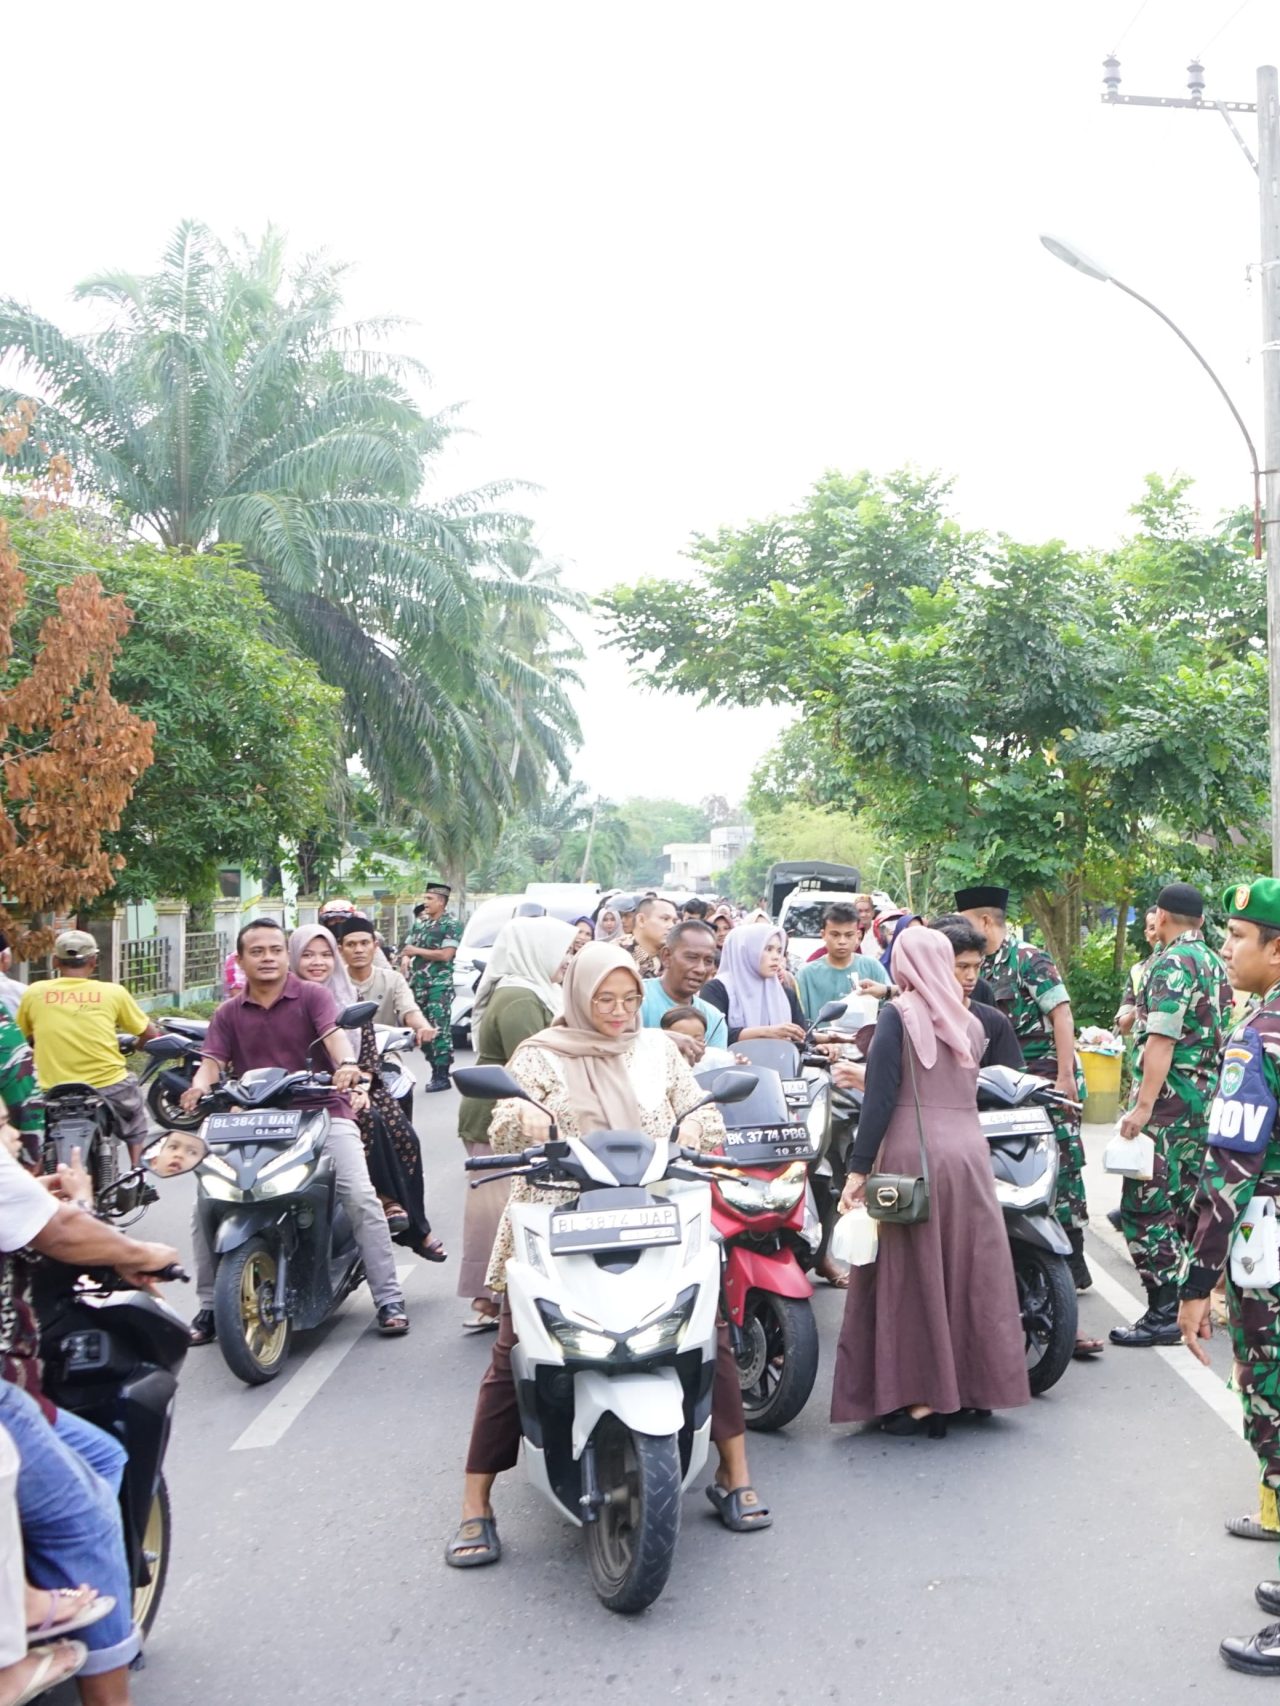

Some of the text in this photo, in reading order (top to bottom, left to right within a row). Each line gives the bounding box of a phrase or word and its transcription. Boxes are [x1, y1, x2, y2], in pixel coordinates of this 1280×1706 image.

[213, 1118, 229, 1128] BL
[268, 1114, 295, 1125] UAK
[726, 1132, 745, 1145] BK
[781, 1127, 807, 1140] PBG
[558, 1219, 578, 1232] BL
[639, 1210, 672, 1225] UAP
